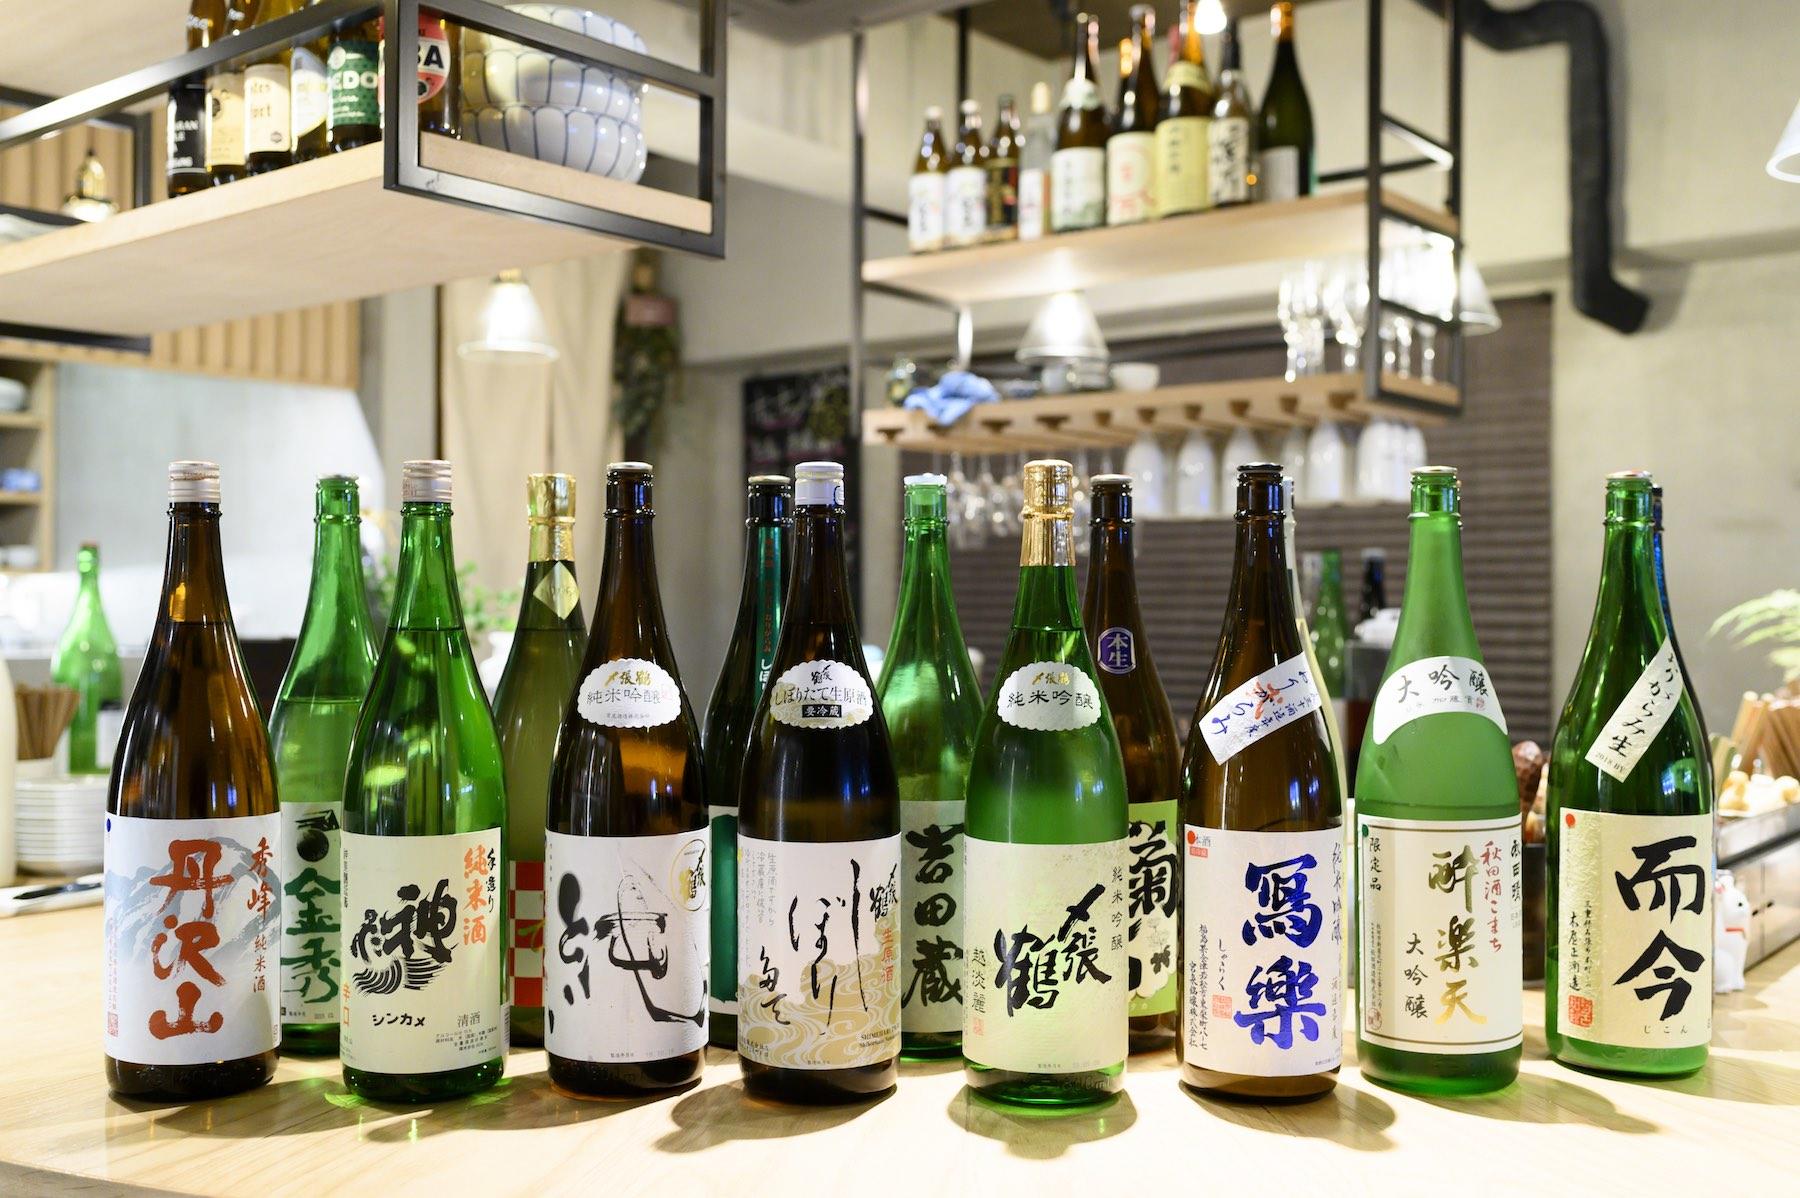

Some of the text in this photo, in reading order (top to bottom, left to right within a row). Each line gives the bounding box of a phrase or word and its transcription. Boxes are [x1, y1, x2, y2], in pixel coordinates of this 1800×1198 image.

[1107, 633, 1128, 667] 本生
[587, 687, 661, 704] 純米吟醸
[804, 705, 841, 718] 要冷蔵
[1007, 689, 1094, 711] 純米吟醸
[1397, 664, 1489, 704] 大吟醸
[1369, 837, 1382, 892] 限定品
[247, 836, 273, 994] 秀峰 純米酒
[462, 844, 487, 946] 純米酒
[1111, 866, 1123, 952] 純米吟醸
[1480, 840, 1502, 953] 秋田酒こまち
[879, 928, 894, 983] 生原酒
[1612, 835, 1706, 1021] 而今
[970, 946, 987, 1015] 越淡麗
[1404, 933, 1429, 1020] 大吟醸
[372, 1012, 426, 1028] シンカメ
[457, 1010, 481, 1027] 清酒
[1643, 1024, 1688, 1035] じこん
